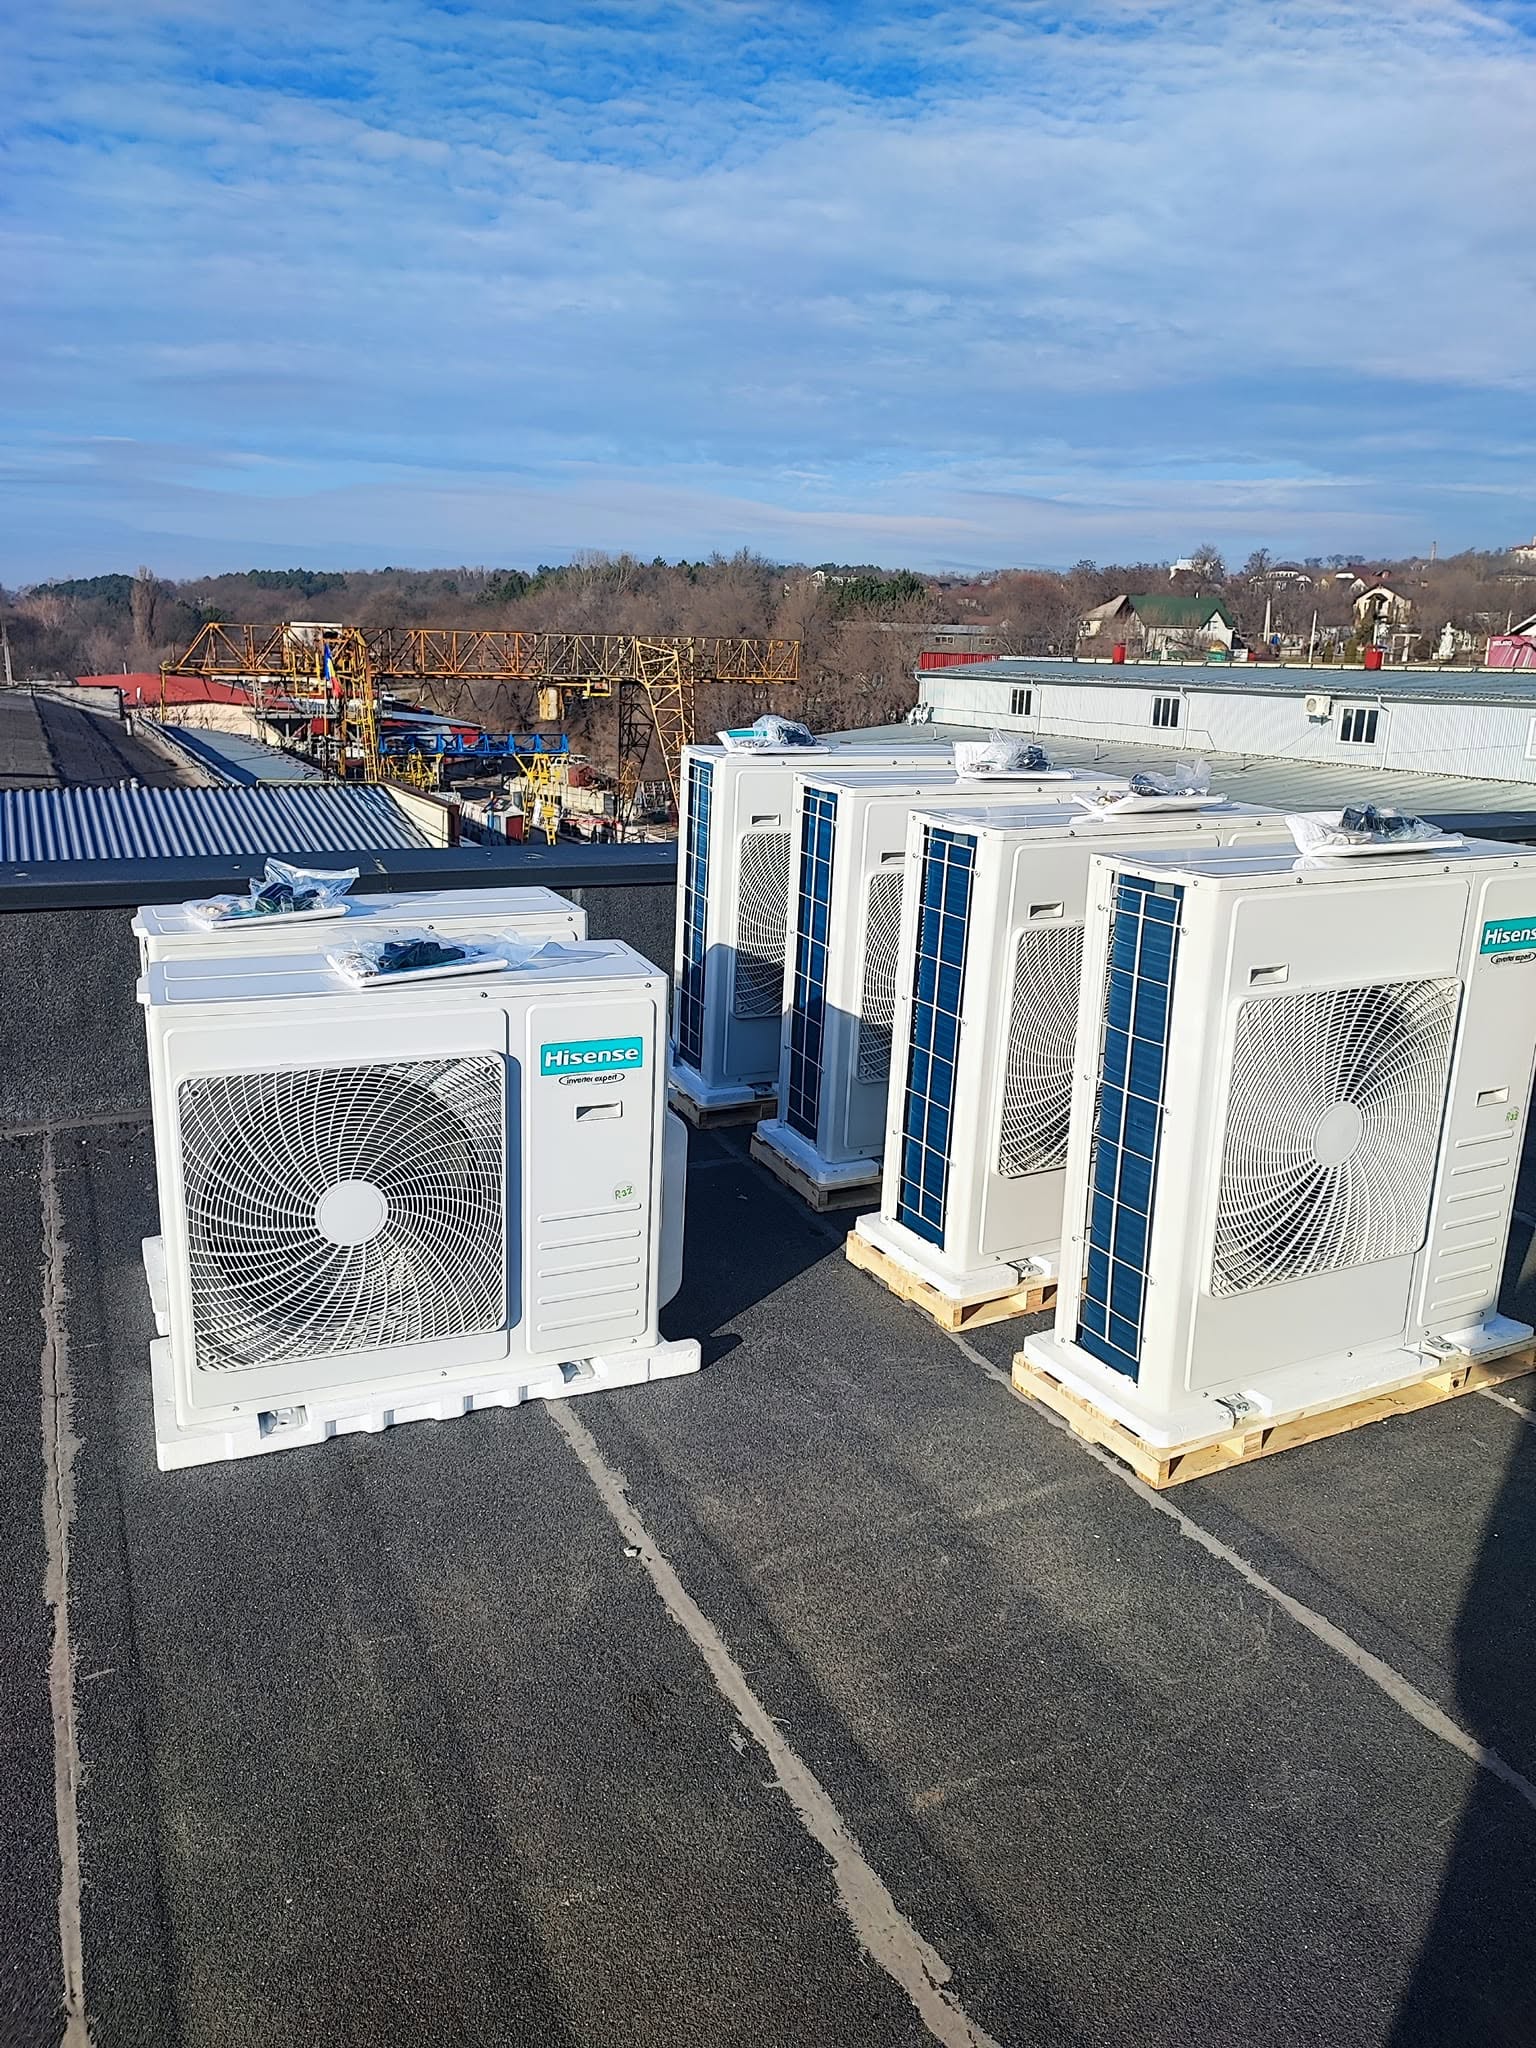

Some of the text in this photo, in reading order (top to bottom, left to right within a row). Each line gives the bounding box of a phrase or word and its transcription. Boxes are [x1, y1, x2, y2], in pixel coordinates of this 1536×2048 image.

[545, 1048, 639, 1067] Hisense
[567, 1074, 618, 1084] inverter expert
